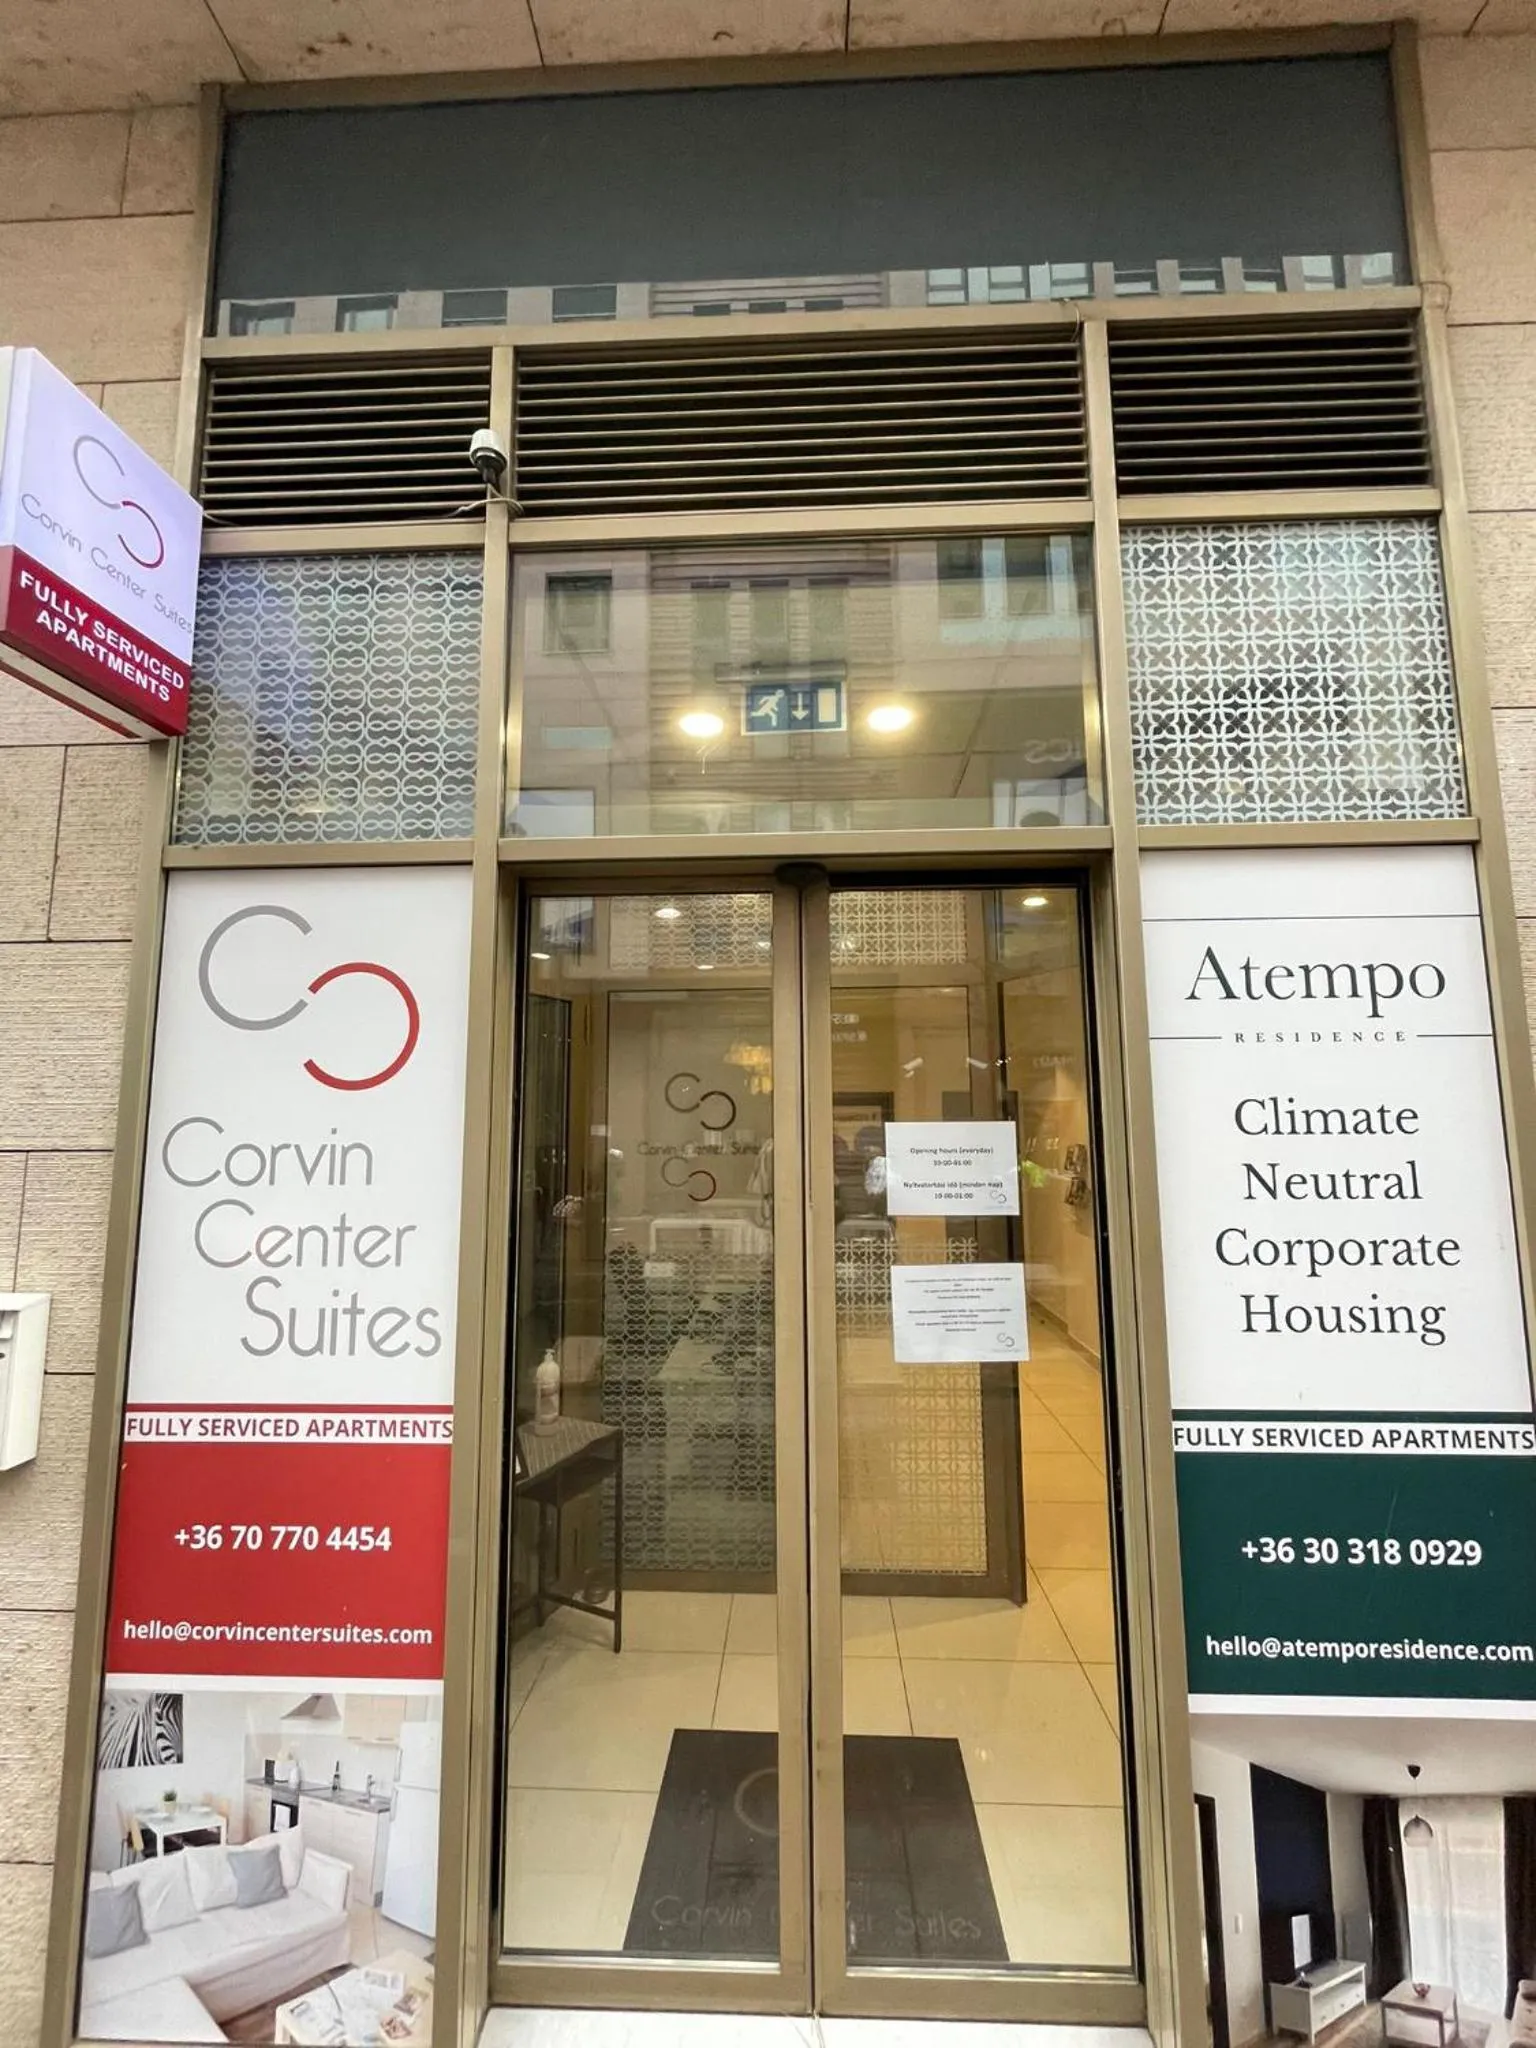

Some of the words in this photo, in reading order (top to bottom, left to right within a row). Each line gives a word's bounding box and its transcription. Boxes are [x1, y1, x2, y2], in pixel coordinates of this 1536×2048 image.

[21, 493, 82, 552] Corvin
[91, 547, 147, 599] Center
[154, 594, 193, 634] Suites
[20, 569, 88, 626] FULLY
[93, 619, 184, 690] SERVICED
[36, 609, 170, 702] APARTMENTS
[1184, 945, 1446, 1018] Atempo
[1235, 1031, 1407, 1043] RESIDENCE
[1234, 1097, 1420, 1136] Climate
[162, 1116, 373, 1187] Corvin
[1241, 1160, 1423, 1201] Neutral
[195, 1199, 417, 1268] Center
[1215, 1228, 1461, 1277] Corporate
[240, 1275, 442, 1358] Suites
[1240, 1293, 1446, 1346] Housing
[127, 1418, 193, 1437] FULLY
[198, 1418, 300, 1437] SERVICED
[306, 1419, 453, 1439] APARTMENTS
[1174, 1427, 1244, 1447] FULLY
[1252, 1428, 1364, 1448] SERVICED
[1372, 1429, 1534, 1450] APARTMENTS
[174, 1524, 223, 1549] +36
[230, 1525, 262, 1550] 70
[270, 1525, 319, 1550] 770
[326, 1526, 392, 1551] 4454
[1241, 1537, 1295, 1563] +36
[1303, 1537, 1339, 1564] 30
[1347, 1538, 1401, 1565] 318
[1409, 1539, 1483, 1566] 0929
[123, 1620, 433, 1644] hello@corvincentersuites.com
[1206, 1635, 1535, 1663] hello@atemporesidence.com
